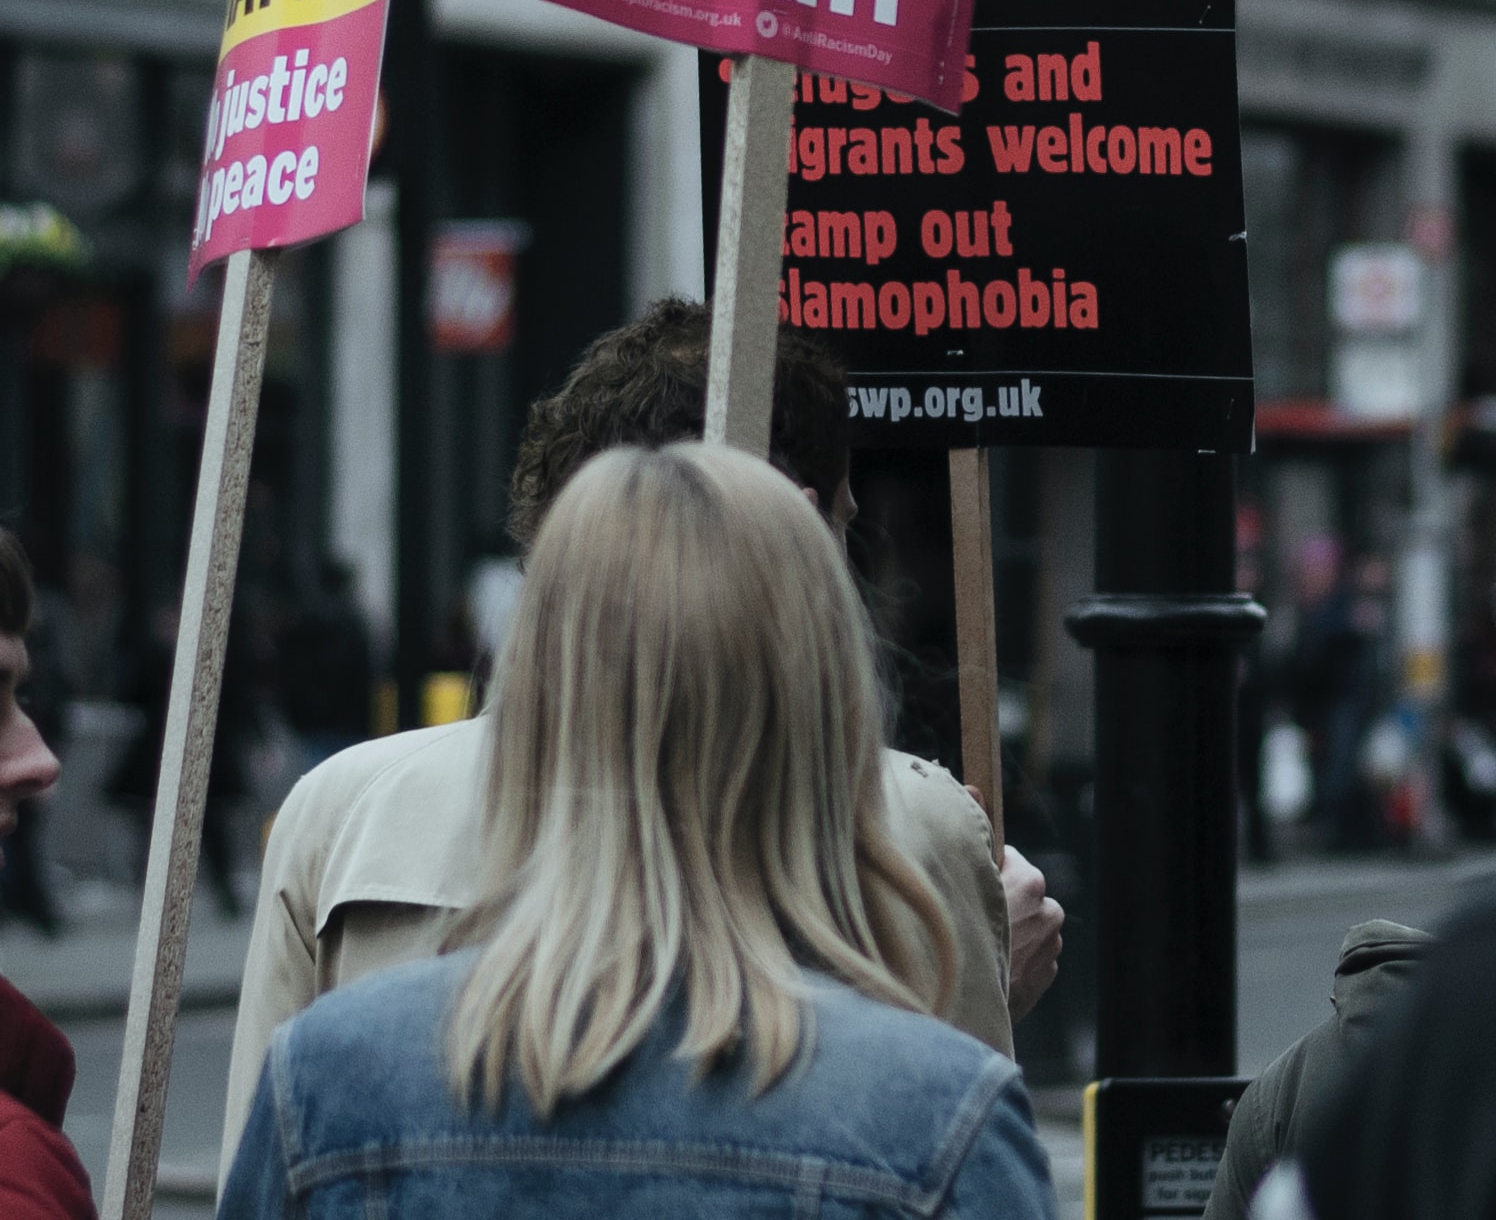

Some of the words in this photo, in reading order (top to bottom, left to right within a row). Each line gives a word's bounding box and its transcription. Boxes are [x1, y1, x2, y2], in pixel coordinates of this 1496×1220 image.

[1004, 42, 1102, 102] and
[214, 48, 347, 161] justice
[787, 116, 965, 181] igrants
[987, 112, 1213, 176] welcome
[205, 145, 319, 242] peace
[921, 200, 1013, 258] out
[1150, 1141, 1226, 1163] PEDES
